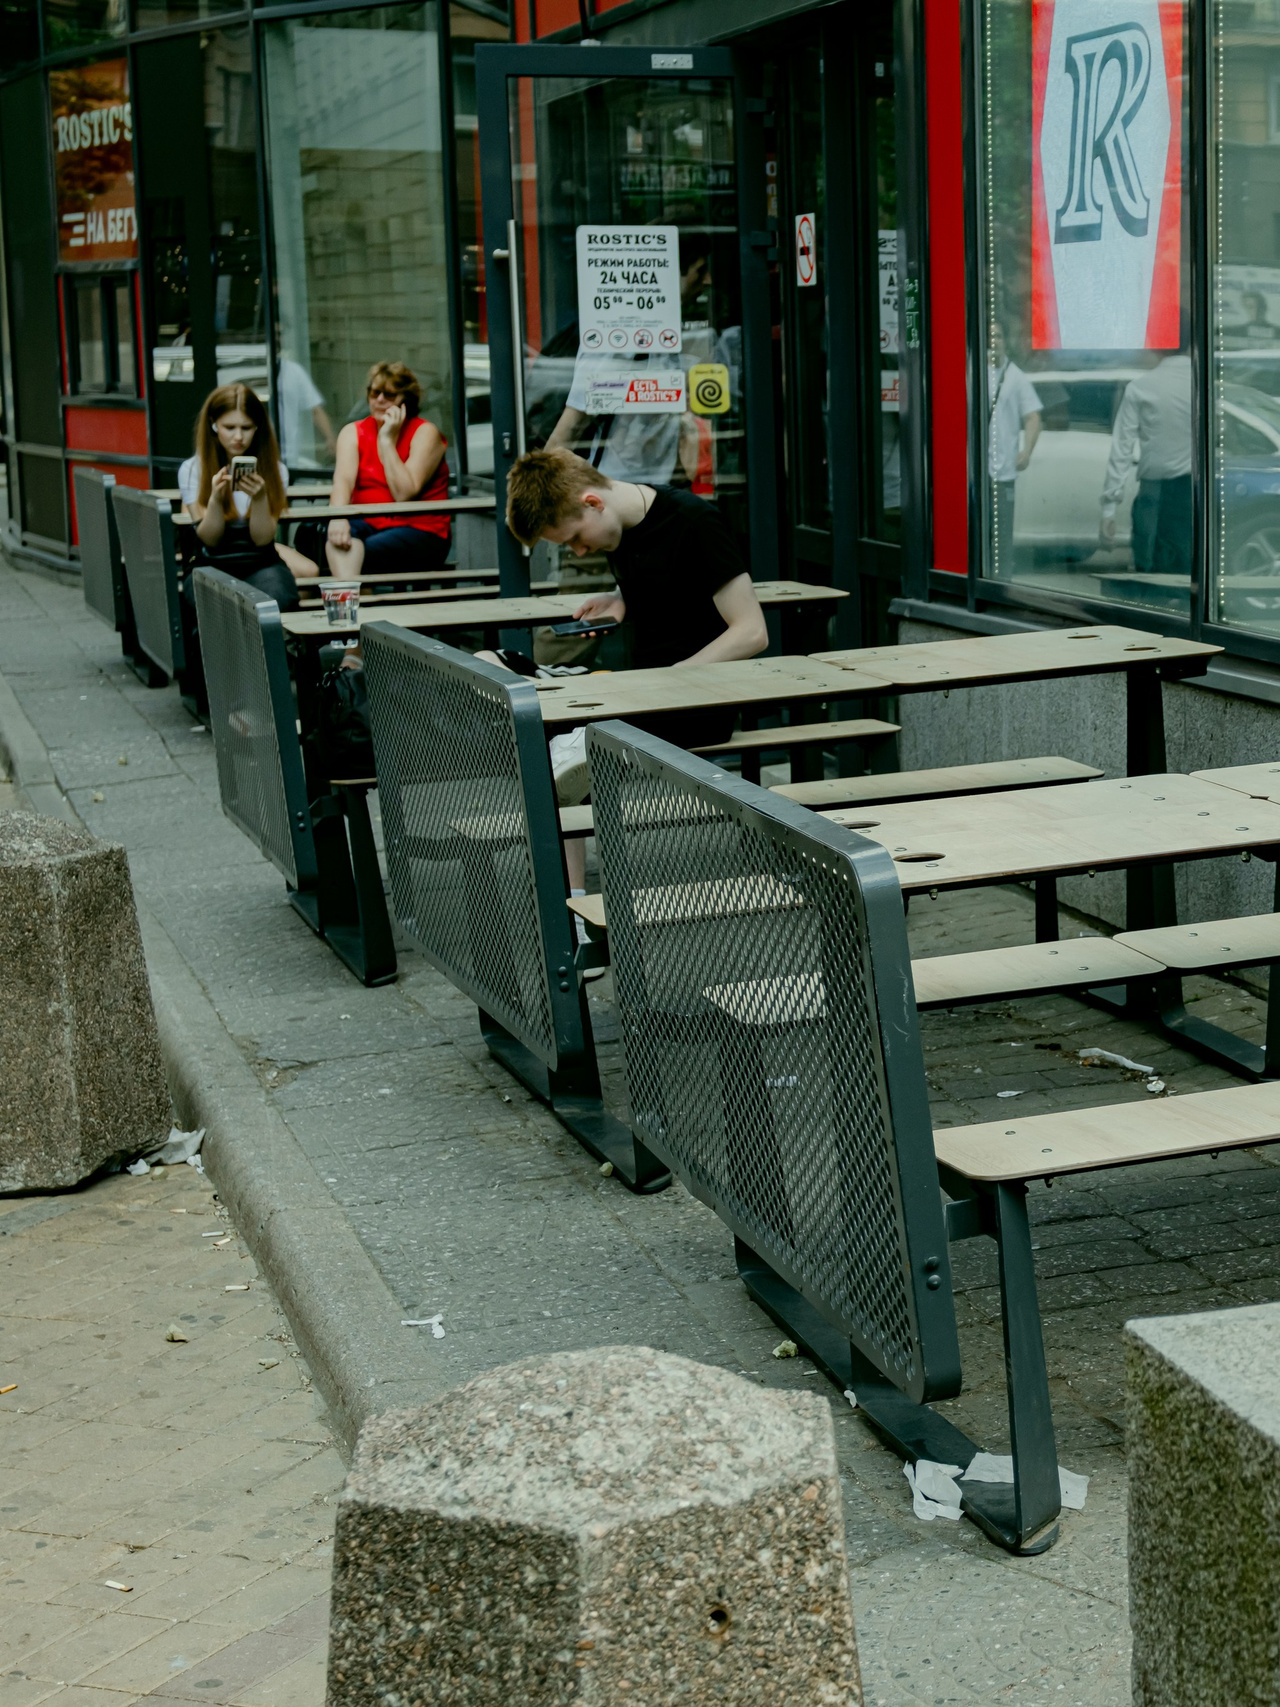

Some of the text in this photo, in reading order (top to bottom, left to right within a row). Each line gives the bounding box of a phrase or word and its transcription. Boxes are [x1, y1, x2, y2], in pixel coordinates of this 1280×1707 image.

[57, 102, 132, 152] ROSTIC'S
[1054, 22, 1151, 244] R
[87, 210, 106, 245] НА
[587, 234, 667, 245] ROSTIC'S
[588, 258, 669, 268] РЕЖИМ РАБОТЫ:
[600, 271, 658, 285] 24 ЧАСА
[633, 380, 657, 392] ЕСТЬ
[638, 391, 677, 401] ROSTIC'S
